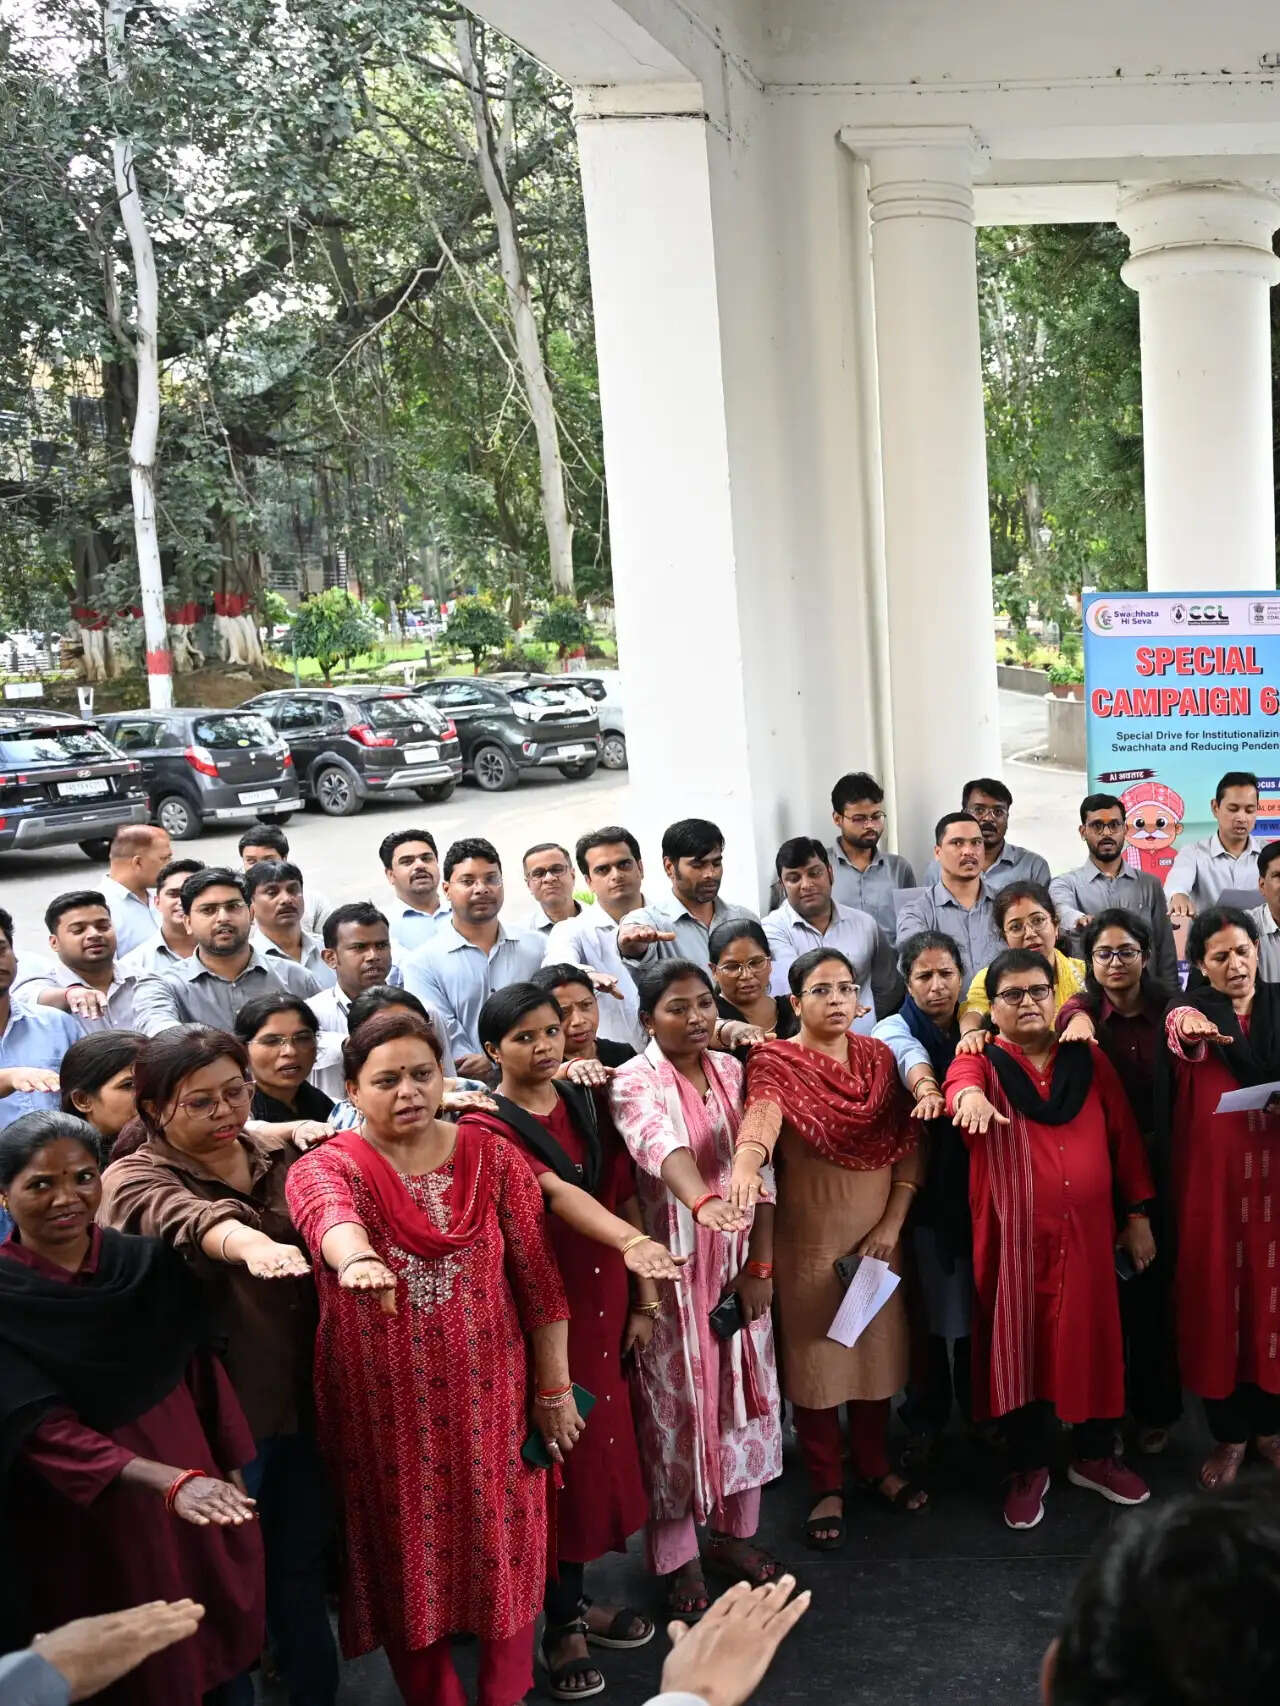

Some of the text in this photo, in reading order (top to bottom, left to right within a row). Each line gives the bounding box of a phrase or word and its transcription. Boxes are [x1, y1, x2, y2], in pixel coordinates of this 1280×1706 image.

[1114, 610, 1159, 618] Swachhata
[1188, 605, 1229, 620] CCL
[1136, 646, 1263, 676] SPECIAL
[1091, 687, 1250, 718] CAMPAIGN
[1117, 731, 1152, 741] Special
[1156, 730, 1183, 739] Drive
[1185, 730, 1200, 739] for
[1112, 743, 1166, 752] Swachhata
[1170, 743, 1188, 752] and
[1193, 742, 1239, 753] Reducing
